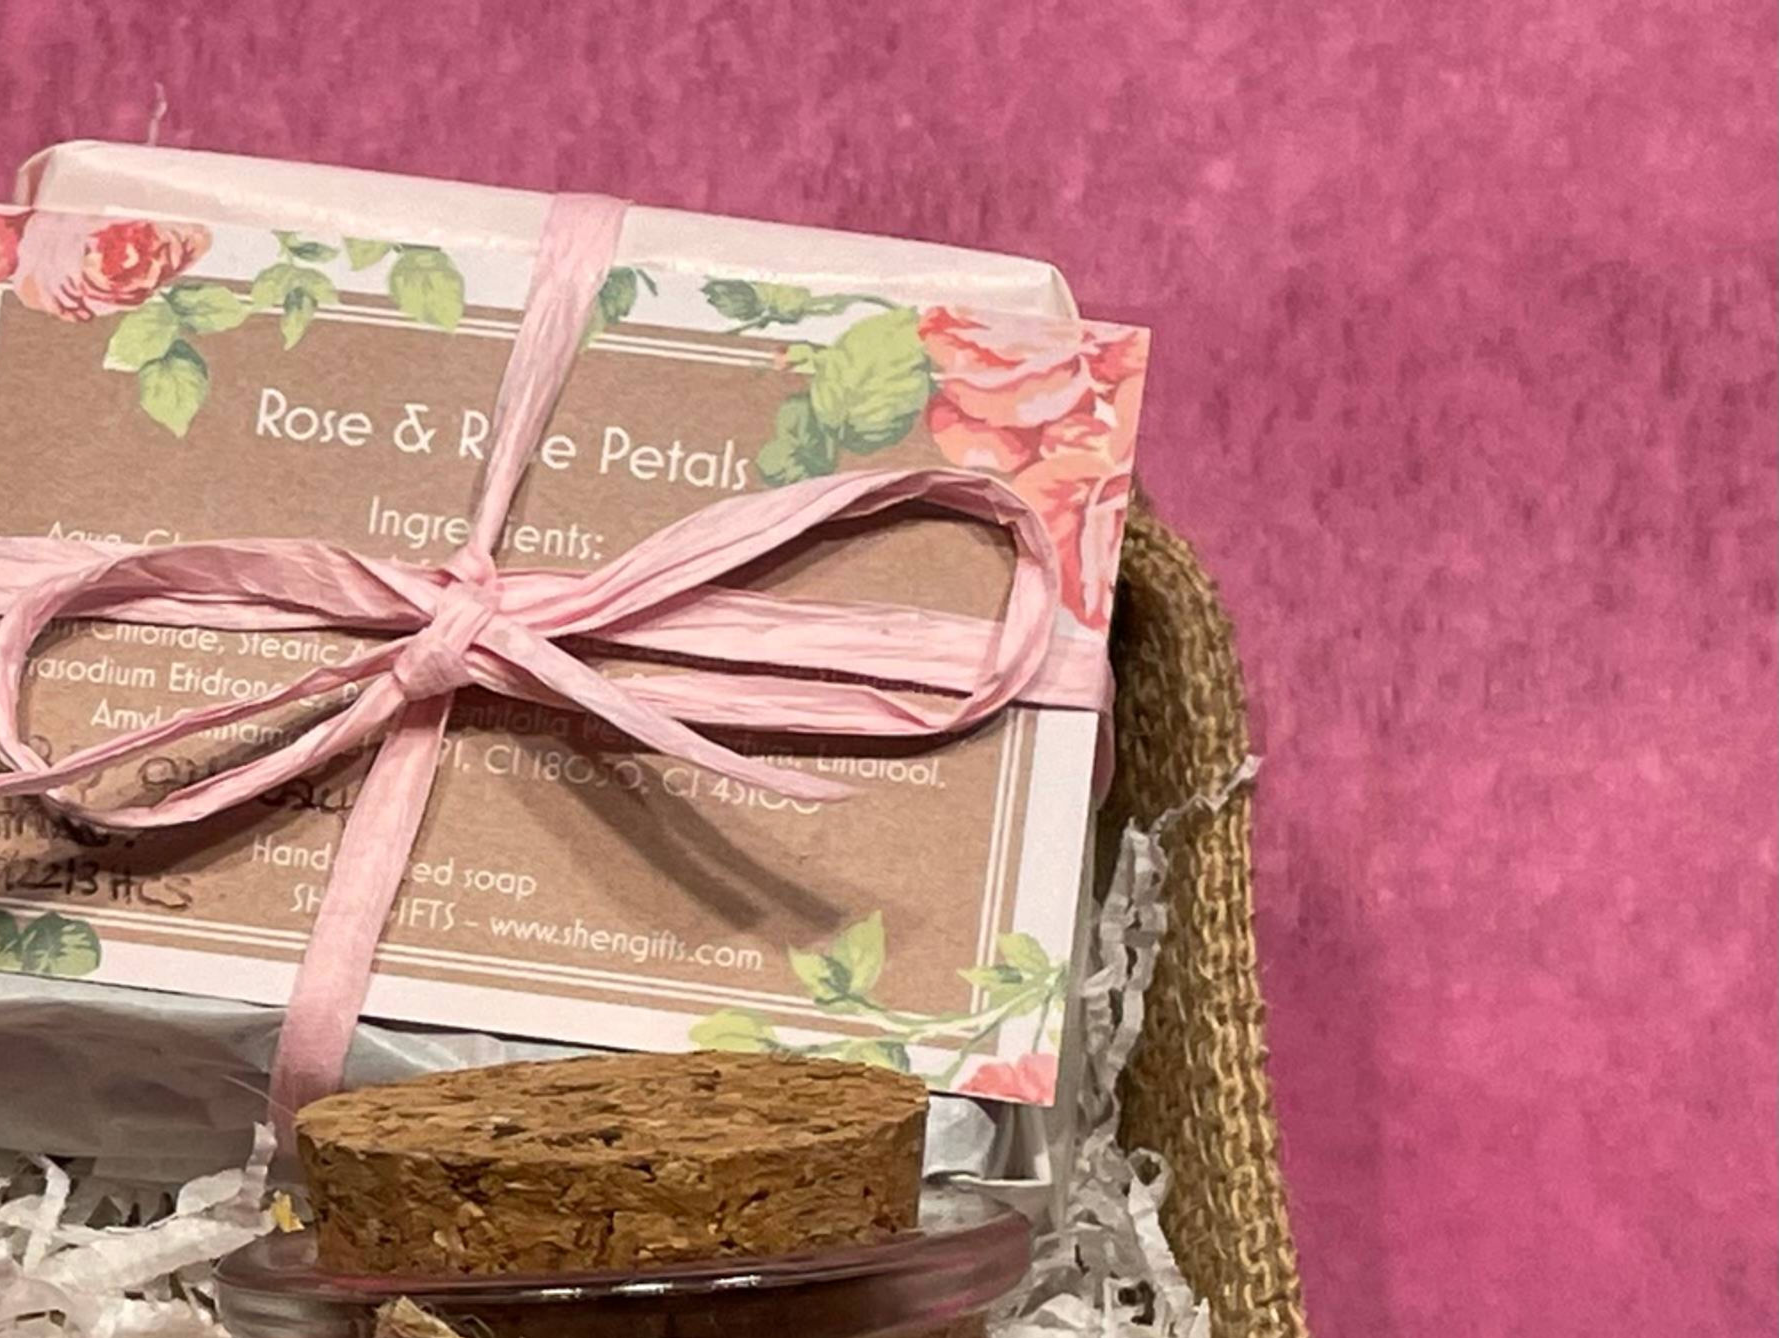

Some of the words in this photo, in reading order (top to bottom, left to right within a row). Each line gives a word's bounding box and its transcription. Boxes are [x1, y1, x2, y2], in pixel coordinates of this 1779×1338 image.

[255, 387, 373, 448] Rose
[392, 403, 437, 455] &
[458, 409, 578, 471] Re
[598, 426, 751, 492] Petals
[368, 496, 606, 560] Ingreients:
[463, 867, 538, 900] soap
[489, 916, 763, 972] www.shengifts.com
